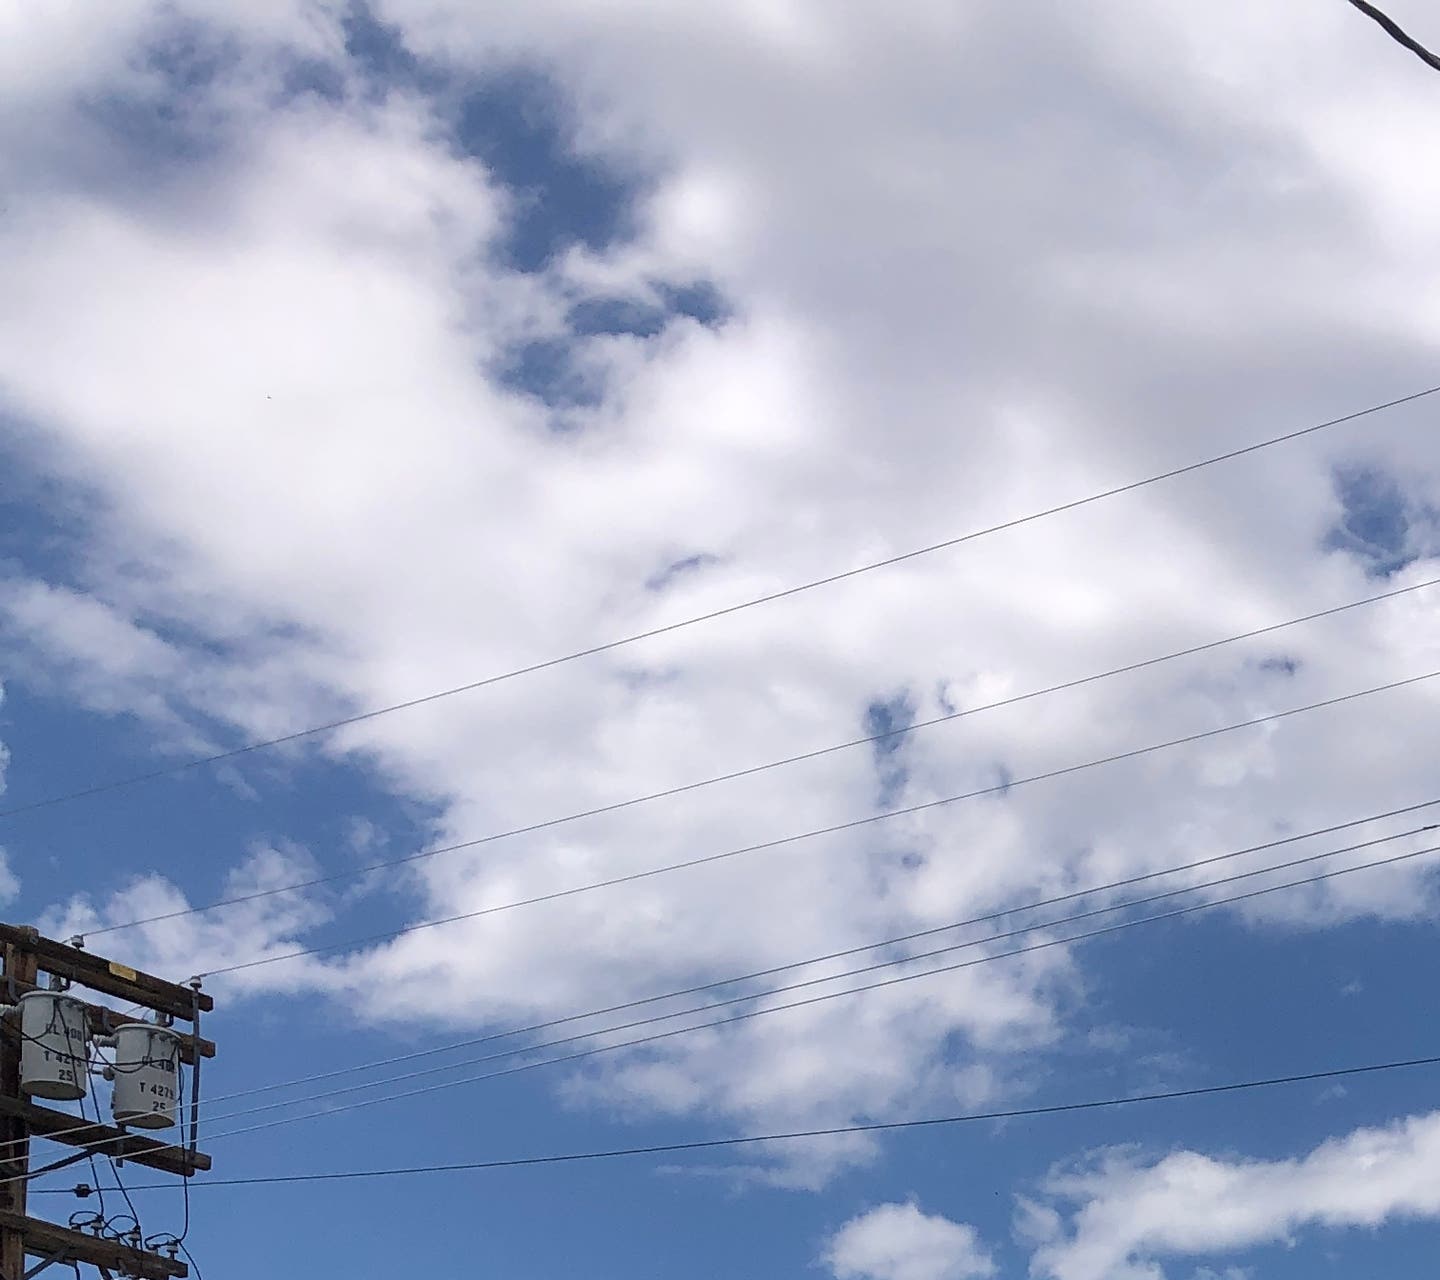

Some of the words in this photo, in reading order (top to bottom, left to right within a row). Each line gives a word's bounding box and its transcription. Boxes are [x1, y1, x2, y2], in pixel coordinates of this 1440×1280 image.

[43, 1050, 50, 1061] T
[58, 1069, 73, 1081] 25
[139, 1082, 146, 1093] T
[152, 1100, 166, 1112] 25
